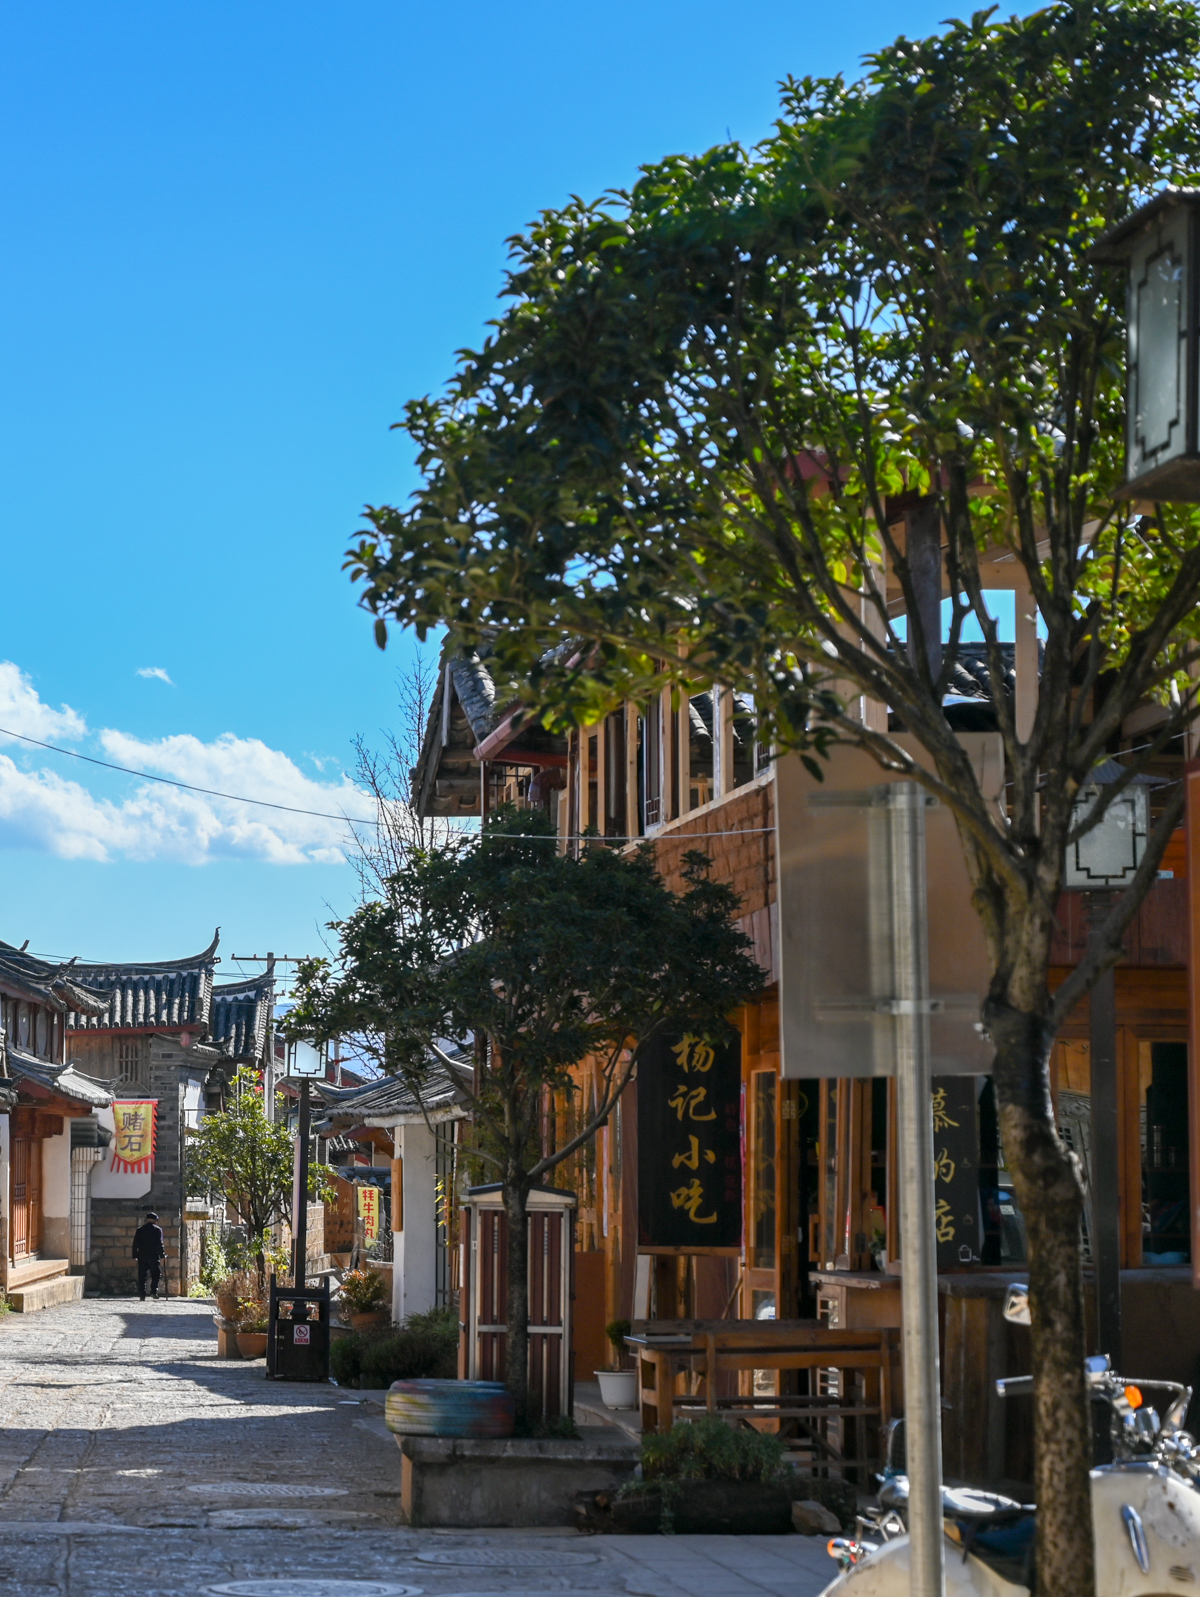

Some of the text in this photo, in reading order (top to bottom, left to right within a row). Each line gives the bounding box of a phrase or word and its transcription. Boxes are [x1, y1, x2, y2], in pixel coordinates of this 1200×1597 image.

[120, 1111, 146, 1153] 赌石
[668, 1033, 718, 1225] 杨记小吃
[362, 1189, 375, 1239] 牦牛肉丸
